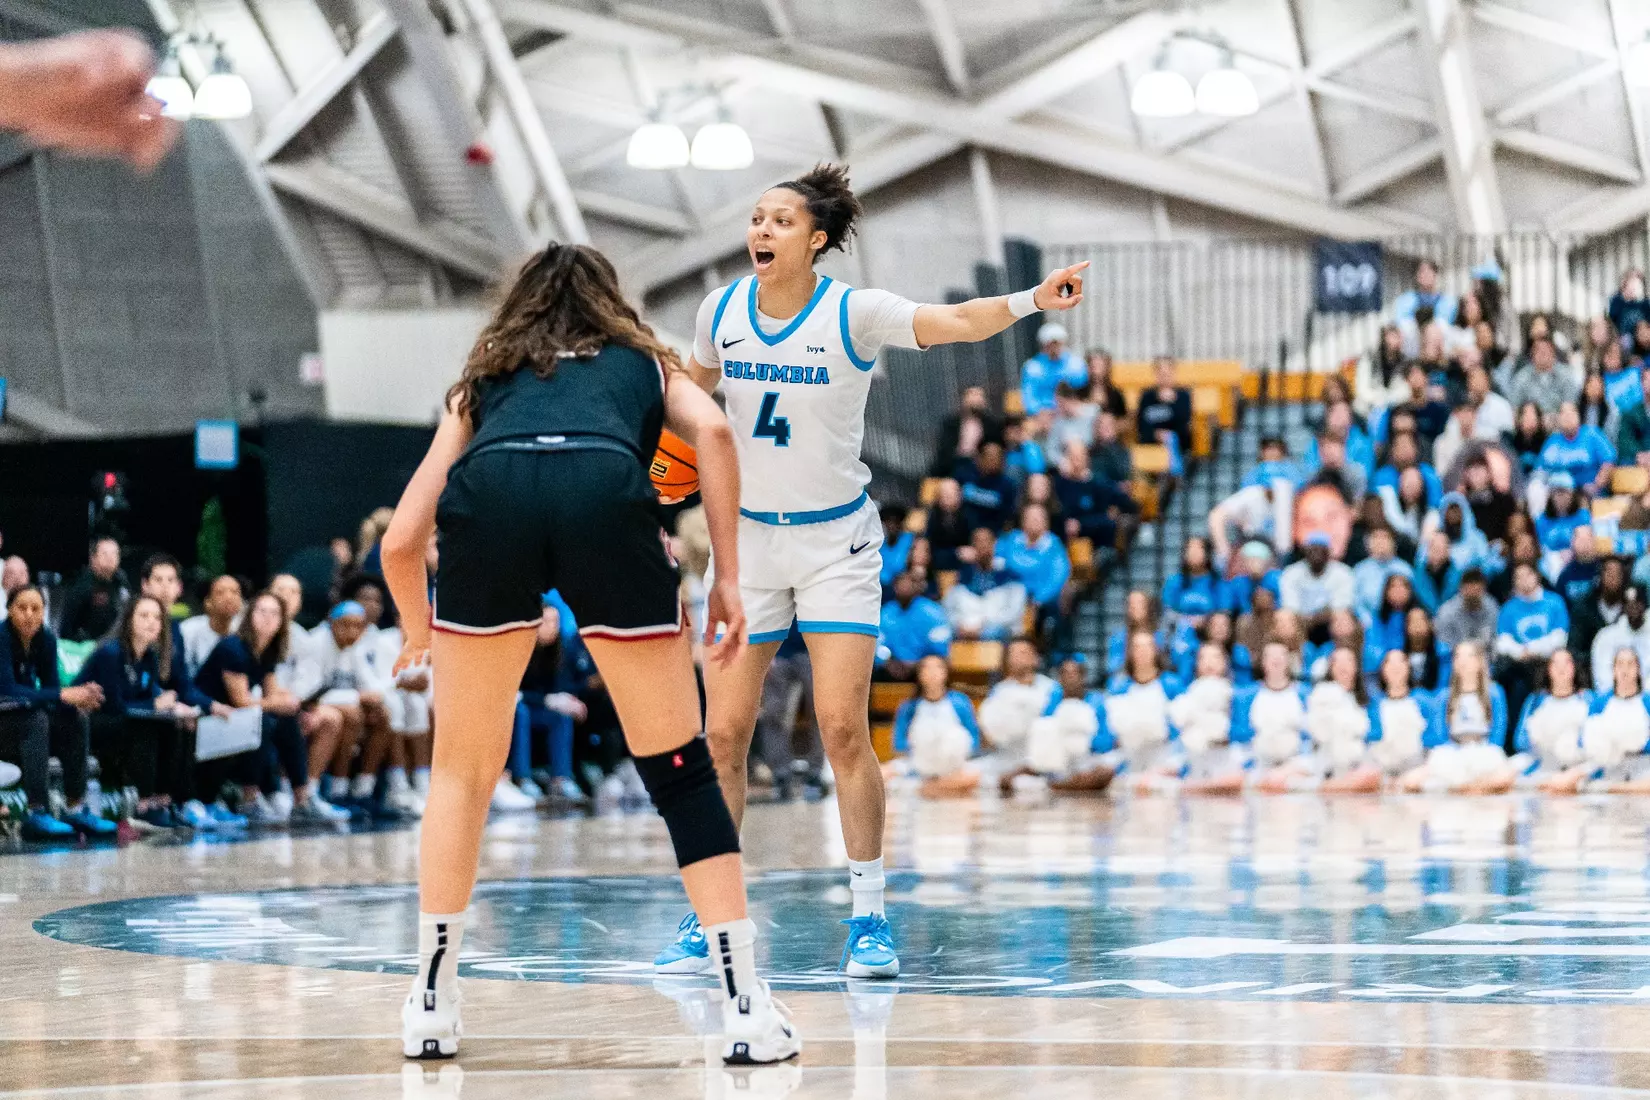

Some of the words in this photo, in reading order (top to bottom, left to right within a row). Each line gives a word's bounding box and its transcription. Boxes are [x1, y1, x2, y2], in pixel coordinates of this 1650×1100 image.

[806, 345, 820, 355] Ivy
[724, 360, 830, 385] COLUMBIA
[752, 391, 791, 447] 4
